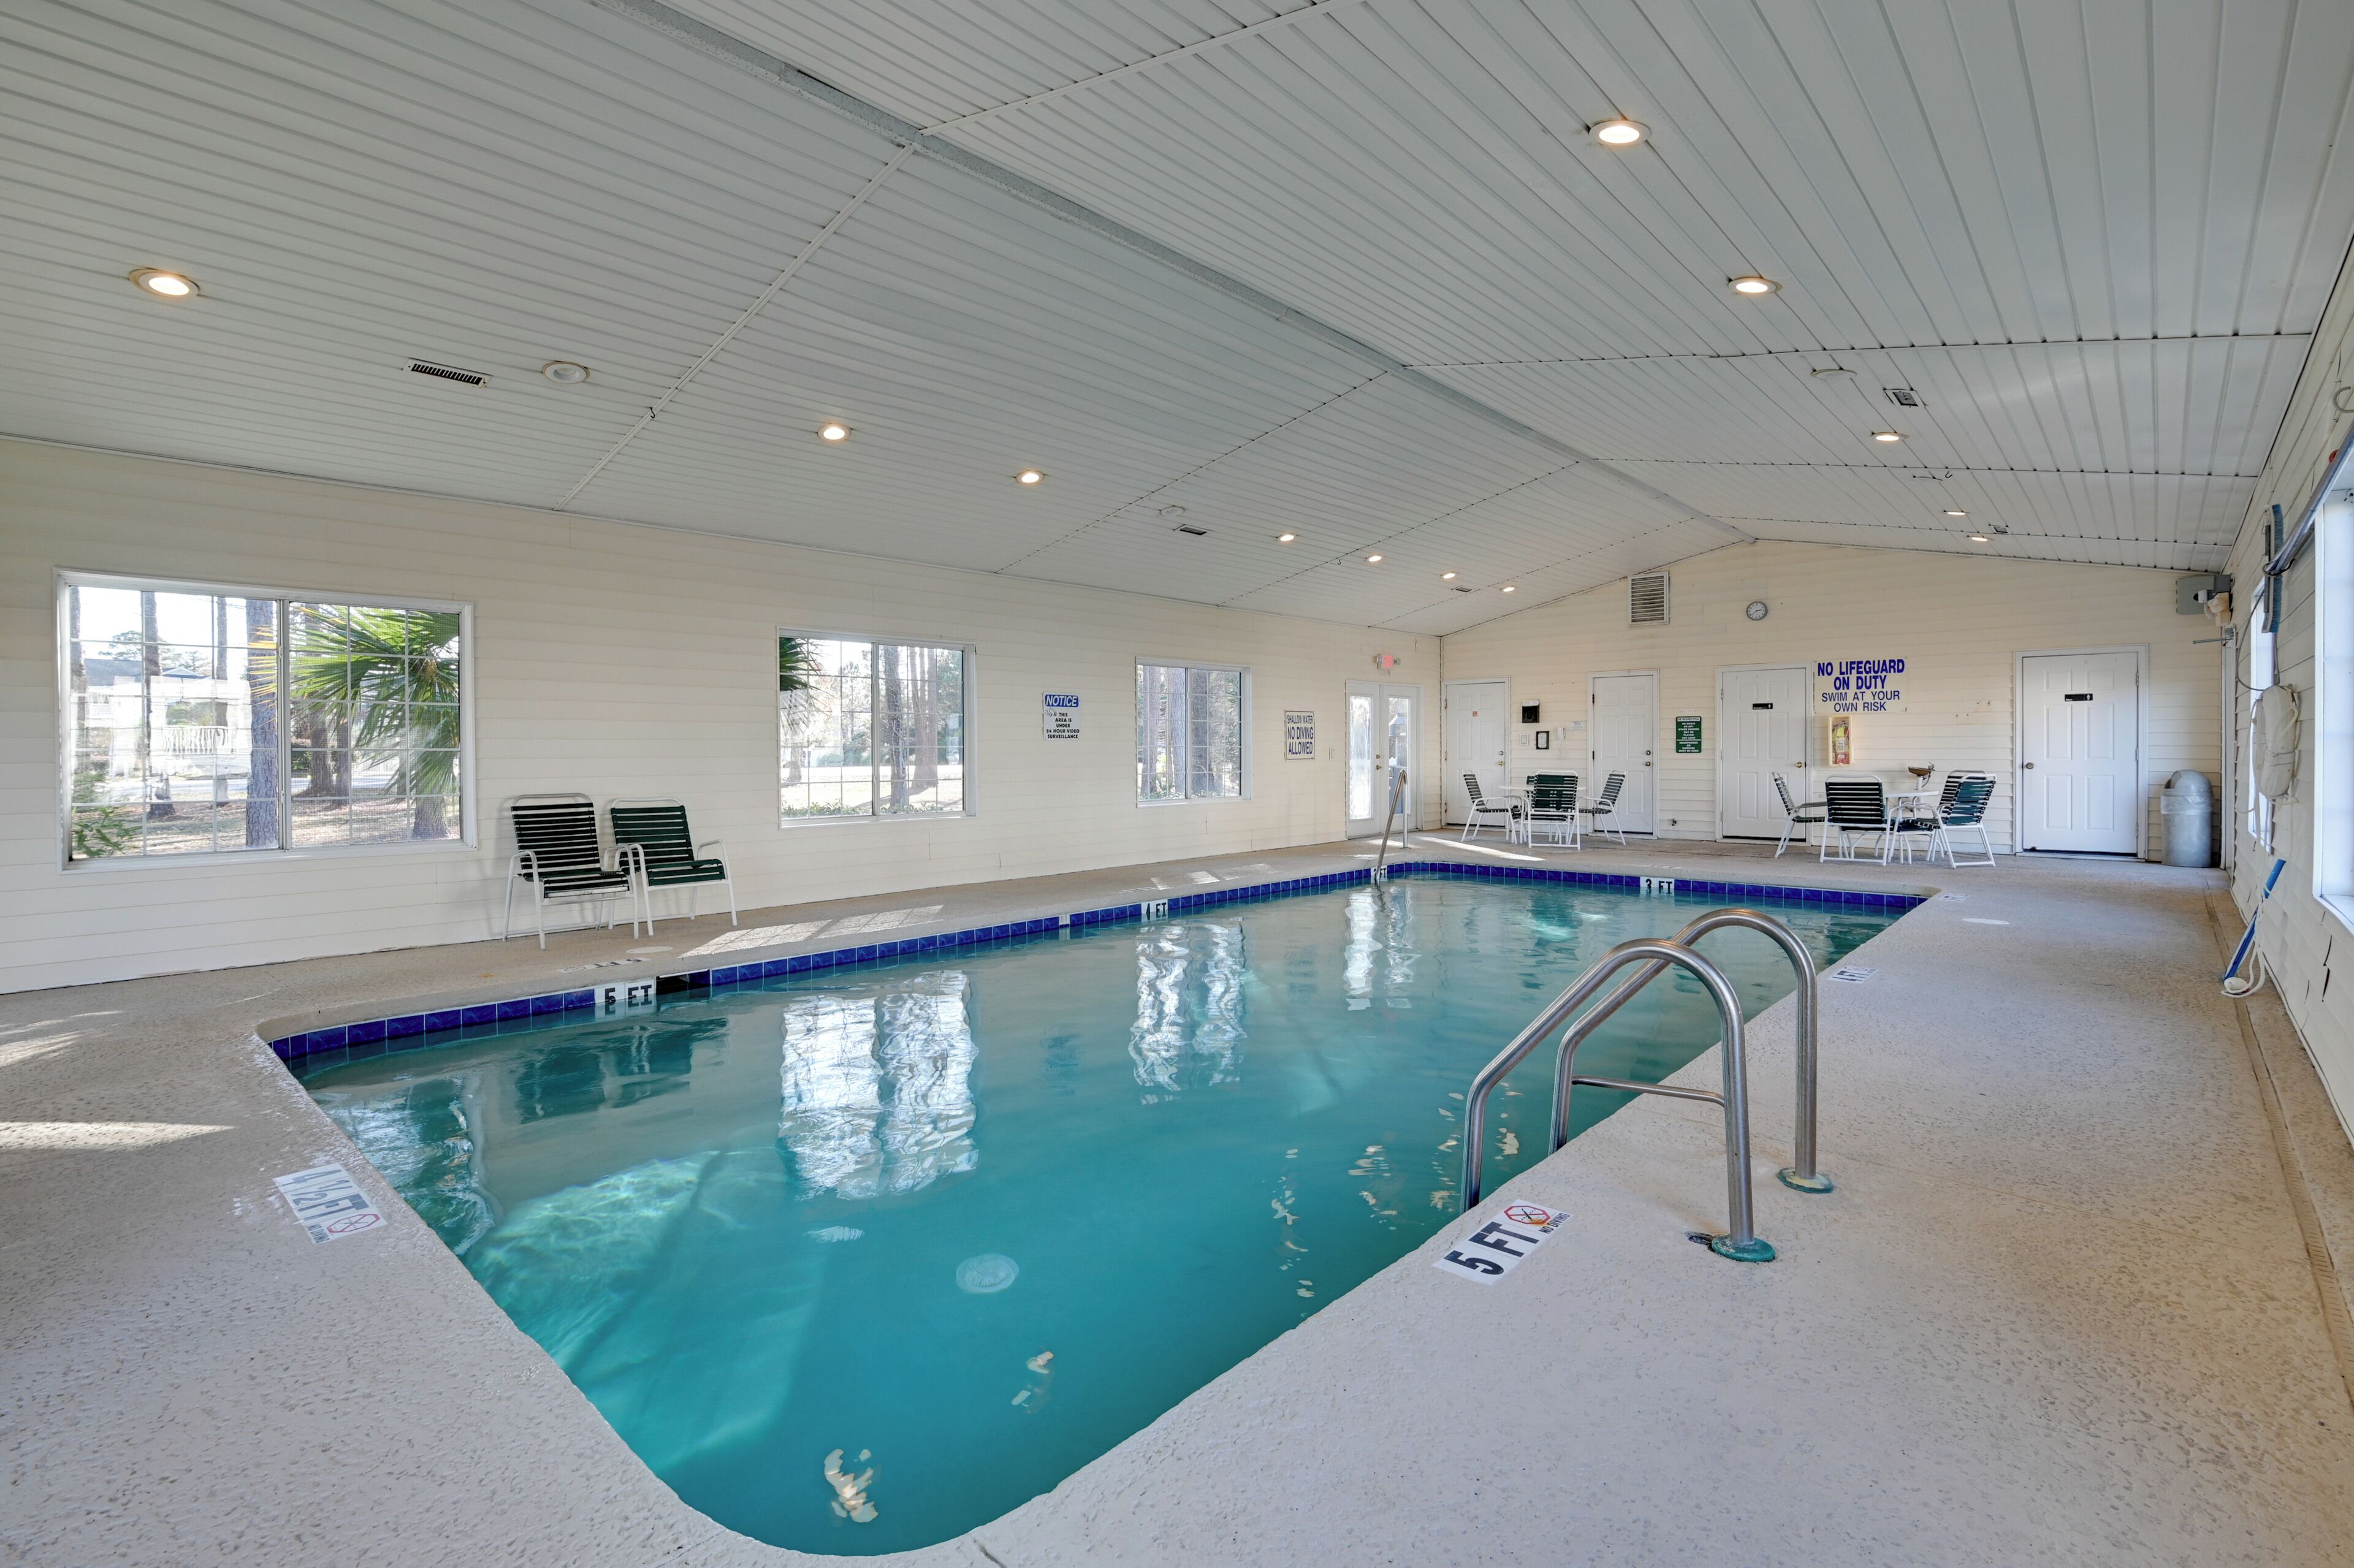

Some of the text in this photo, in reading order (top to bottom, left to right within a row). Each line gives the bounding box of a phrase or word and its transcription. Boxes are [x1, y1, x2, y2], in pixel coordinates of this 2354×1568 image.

[1818, 659, 1905, 677] NO LIFEGUARD
[1834, 675, 1887, 691] ON DUTY
[1046, 695, 1078, 707] NOTICE
[1821, 690, 1900, 702] SWIM AT YOUR
[1834, 701, 1887, 712] OWN RISK
[1287, 715, 1313, 724] SHALLOW WATER
[1287, 726, 1314, 740] NO DIVING
[1288, 741, 1313, 755] ALLOWED
[1156, 902, 1167, 913] FT
[604, 984, 652, 1004] 5 FT
[298, 1193, 370, 1221] FT
[1538, 1212, 1571, 1235] NO DIVING
[1443, 1221, 1540, 1275] 5 FT
